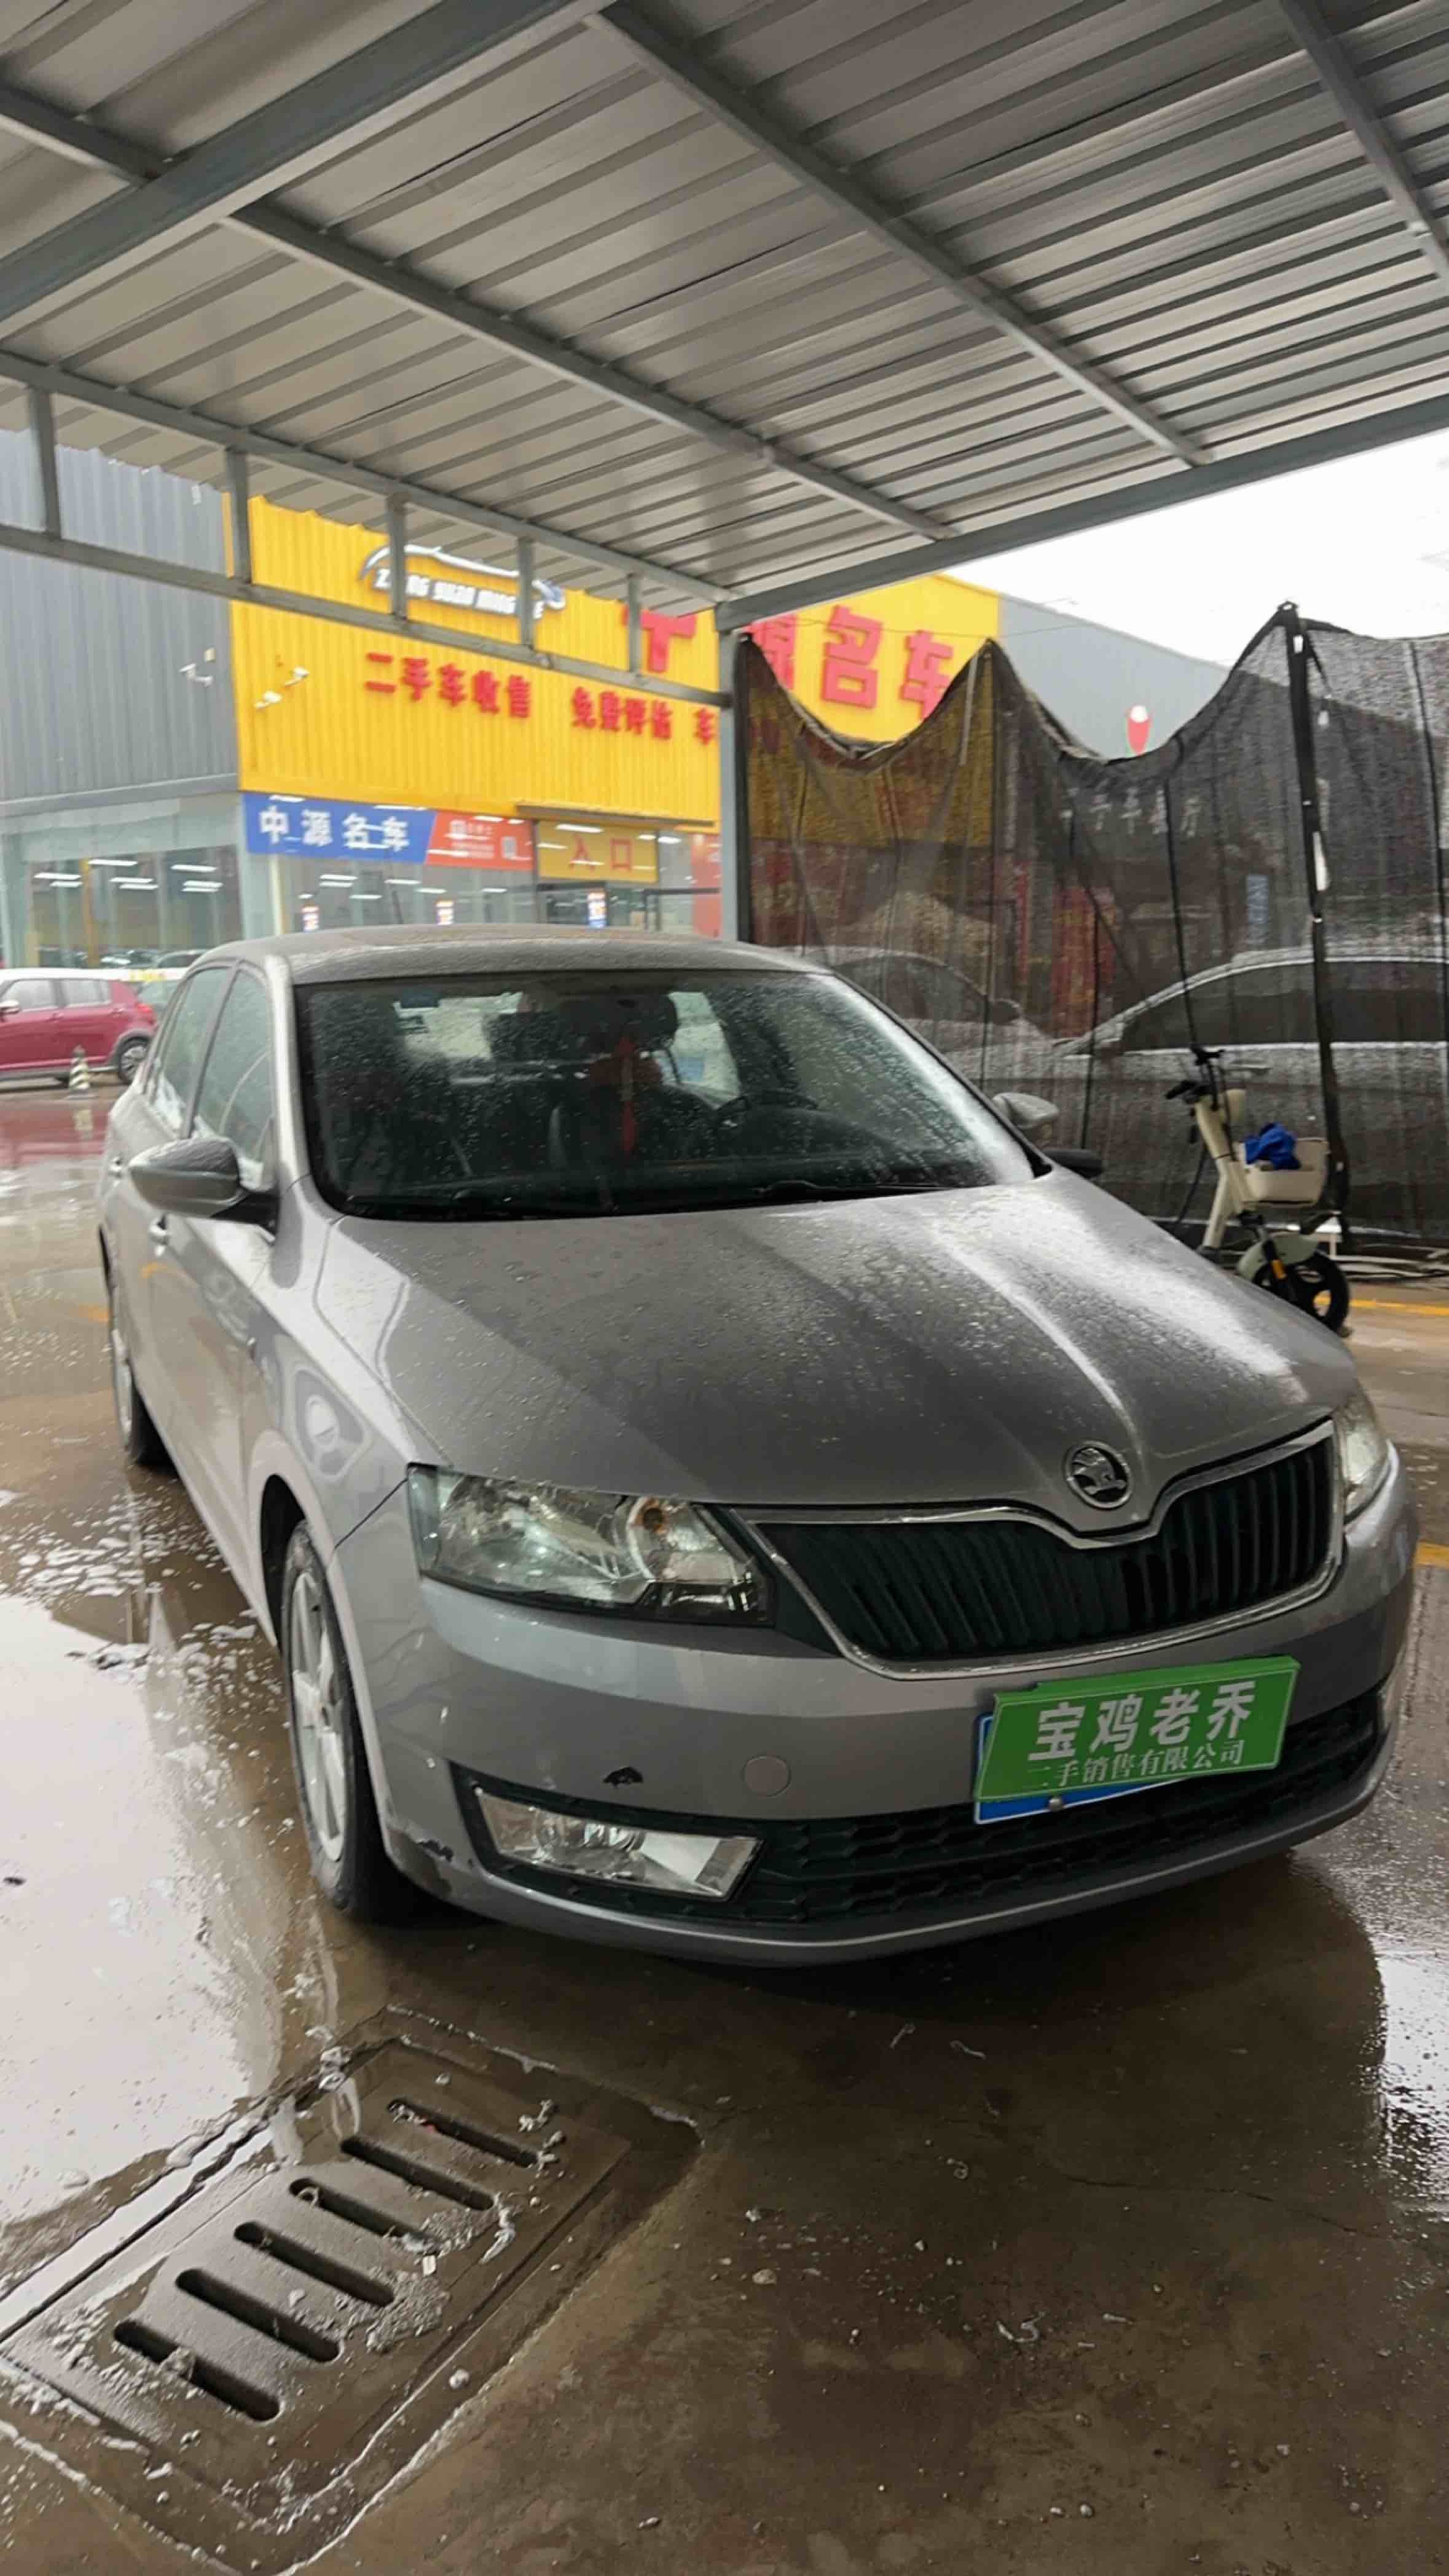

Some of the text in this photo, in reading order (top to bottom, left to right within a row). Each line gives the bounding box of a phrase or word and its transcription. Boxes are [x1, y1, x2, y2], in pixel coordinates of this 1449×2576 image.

[258, 804, 410, 852] 中源名车
[1027, 1680, 1257, 1761] 宝鸡老乔
